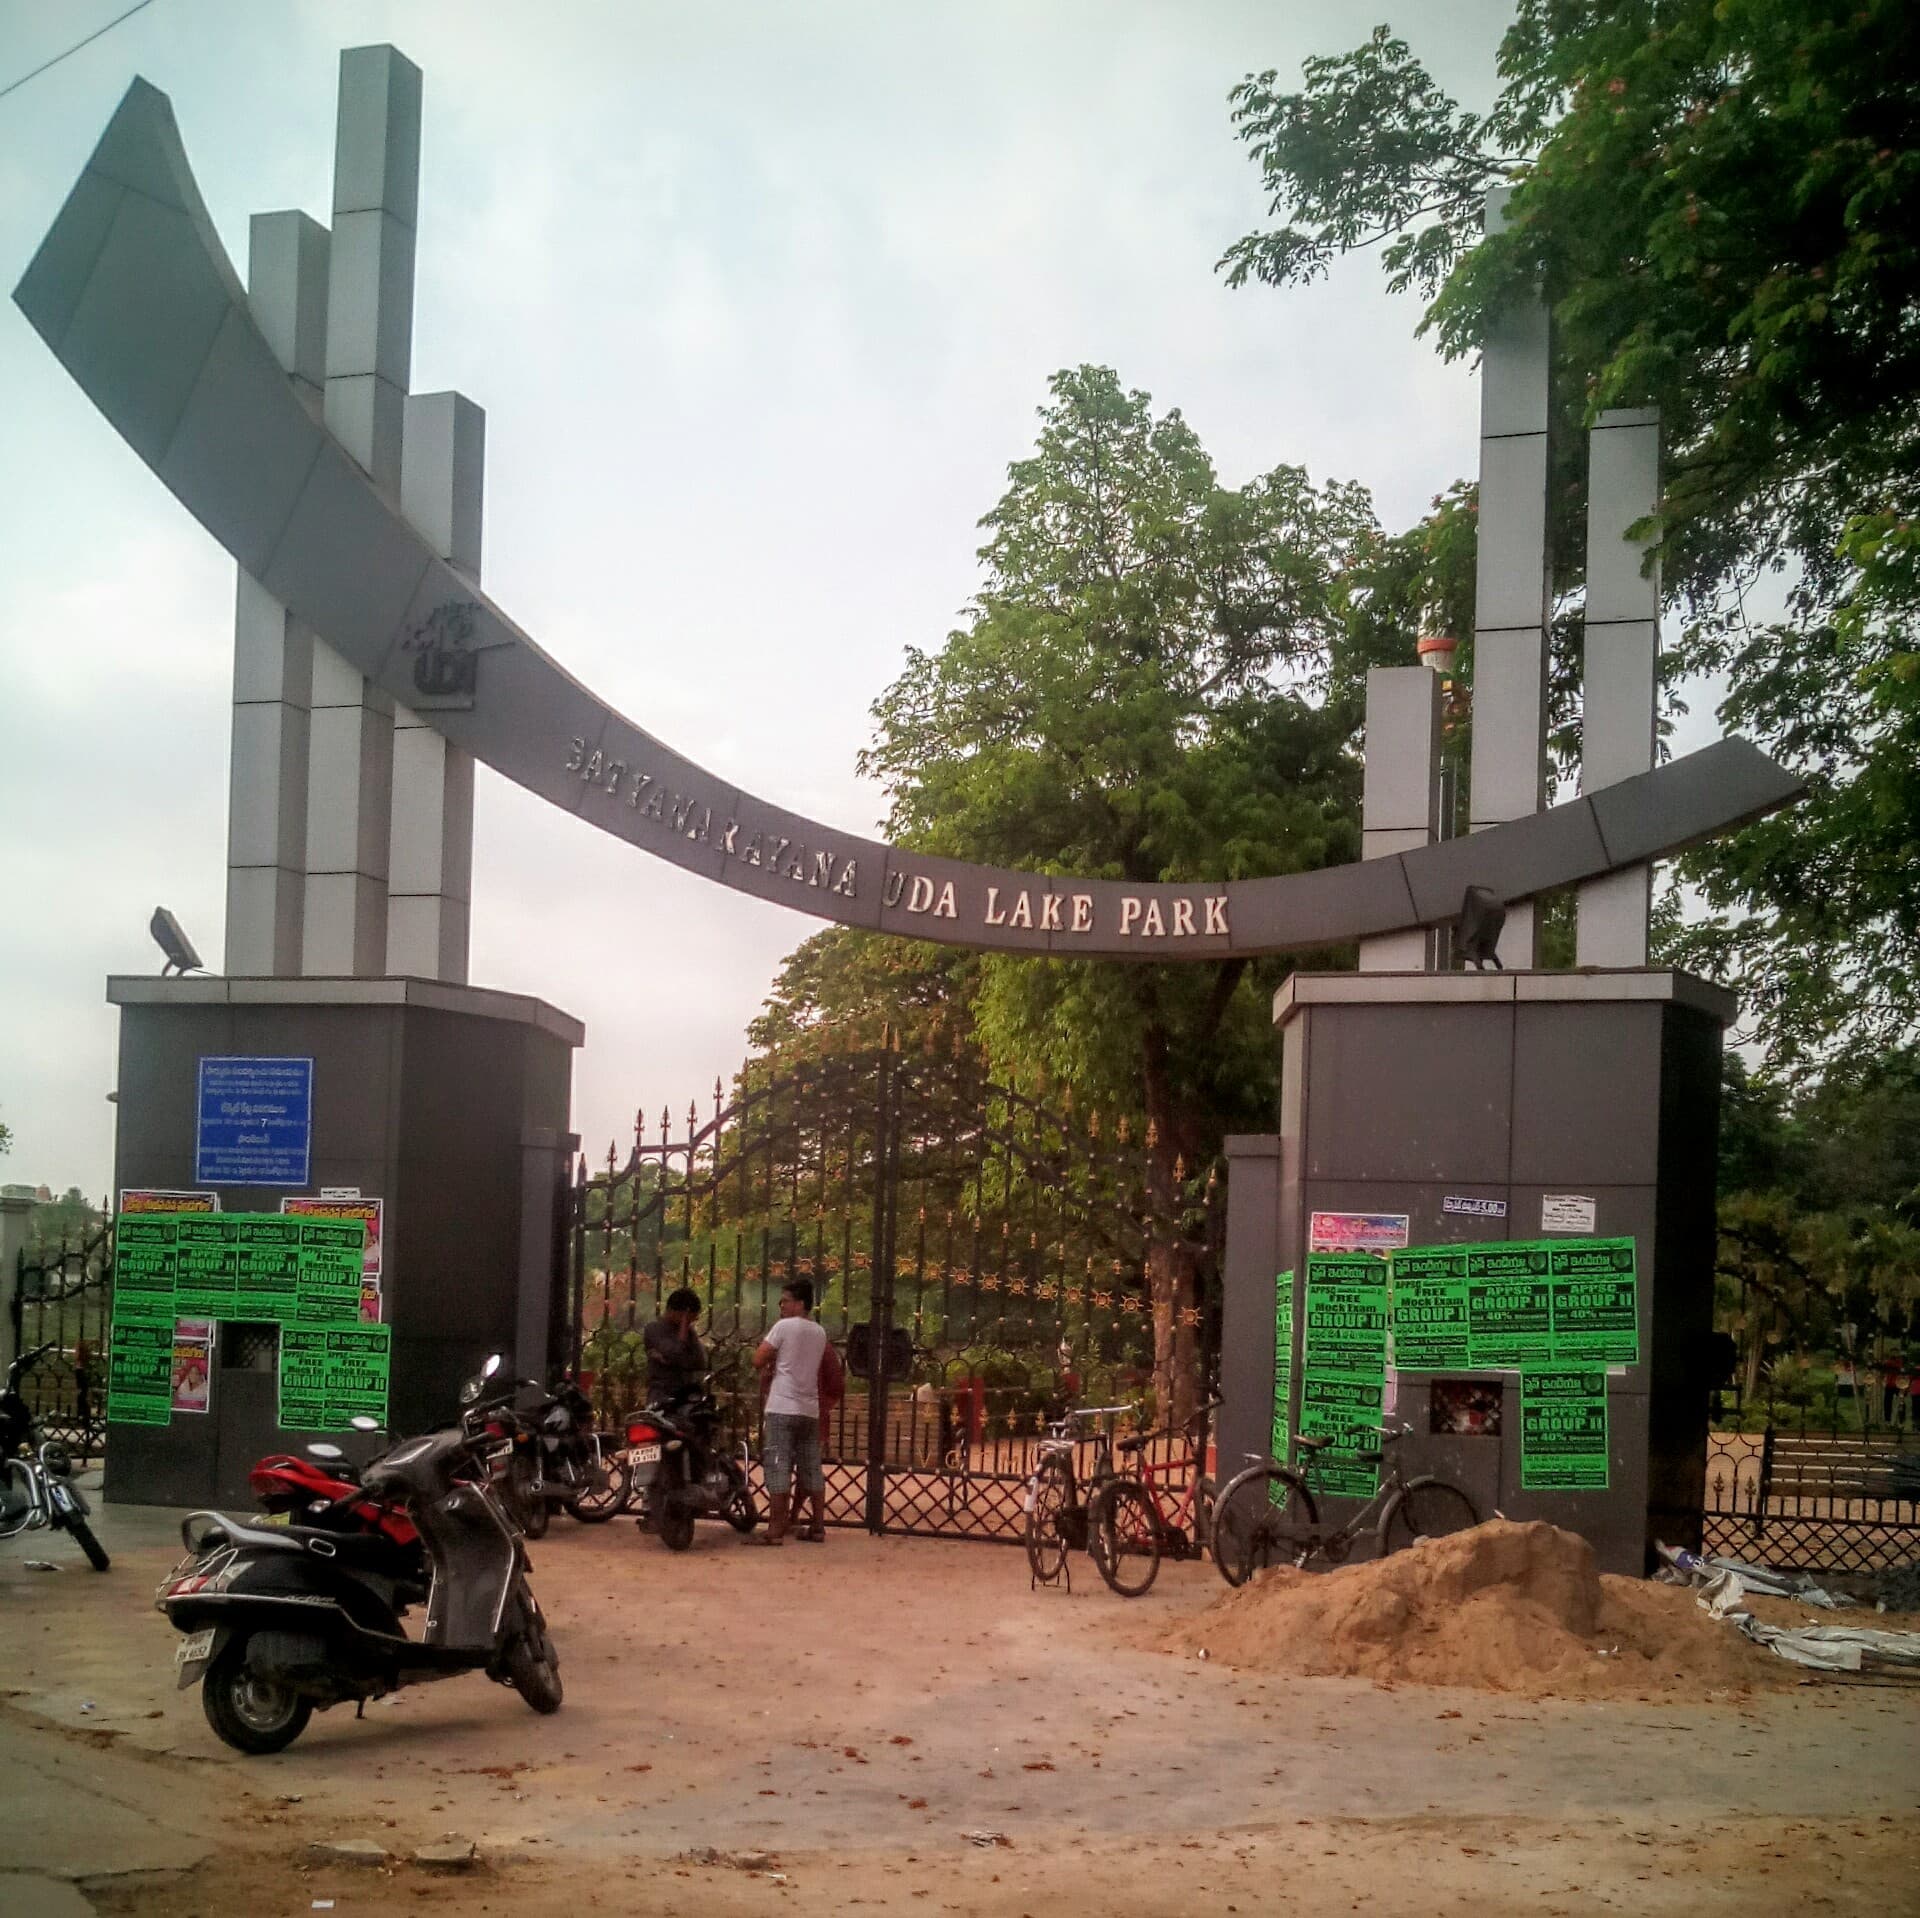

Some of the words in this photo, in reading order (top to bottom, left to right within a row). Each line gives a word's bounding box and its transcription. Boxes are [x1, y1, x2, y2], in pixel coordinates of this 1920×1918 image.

[882, 871, 959, 919] UDA
[984, 887, 1093, 932] LAKE
[1119, 896, 1230, 937] PARK
[301, 1269, 346, 1283] GROUP
[1415, 1288, 1447, 1297] FREE
[1486, 1286, 1533, 1296] APPSC
[1570, 1284, 1617, 1294] APPSC
[1328, 1294, 1361, 1303] FREE
[1401, 1297, 1431, 1306] Mock
[1433, 1297, 1464, 1305] Exam
[1471, 1296, 1531, 1310] GROUP
[1555, 1294, 1615, 1308] GROUP
[1315, 1303, 1345, 1311] Mock
[1347, 1304, 1377, 1313] Exam
[1311, 1312, 1367, 1328] GROUP
[1396, 1307, 1455, 1322] GROUP
[327, 1376, 372, 1389] GROUP
[1323, 1412, 1354, 1421] FREE
[1541, 1407, 1587, 1417] APPSC
[1526, 1417, 1586, 1430] GROUP
